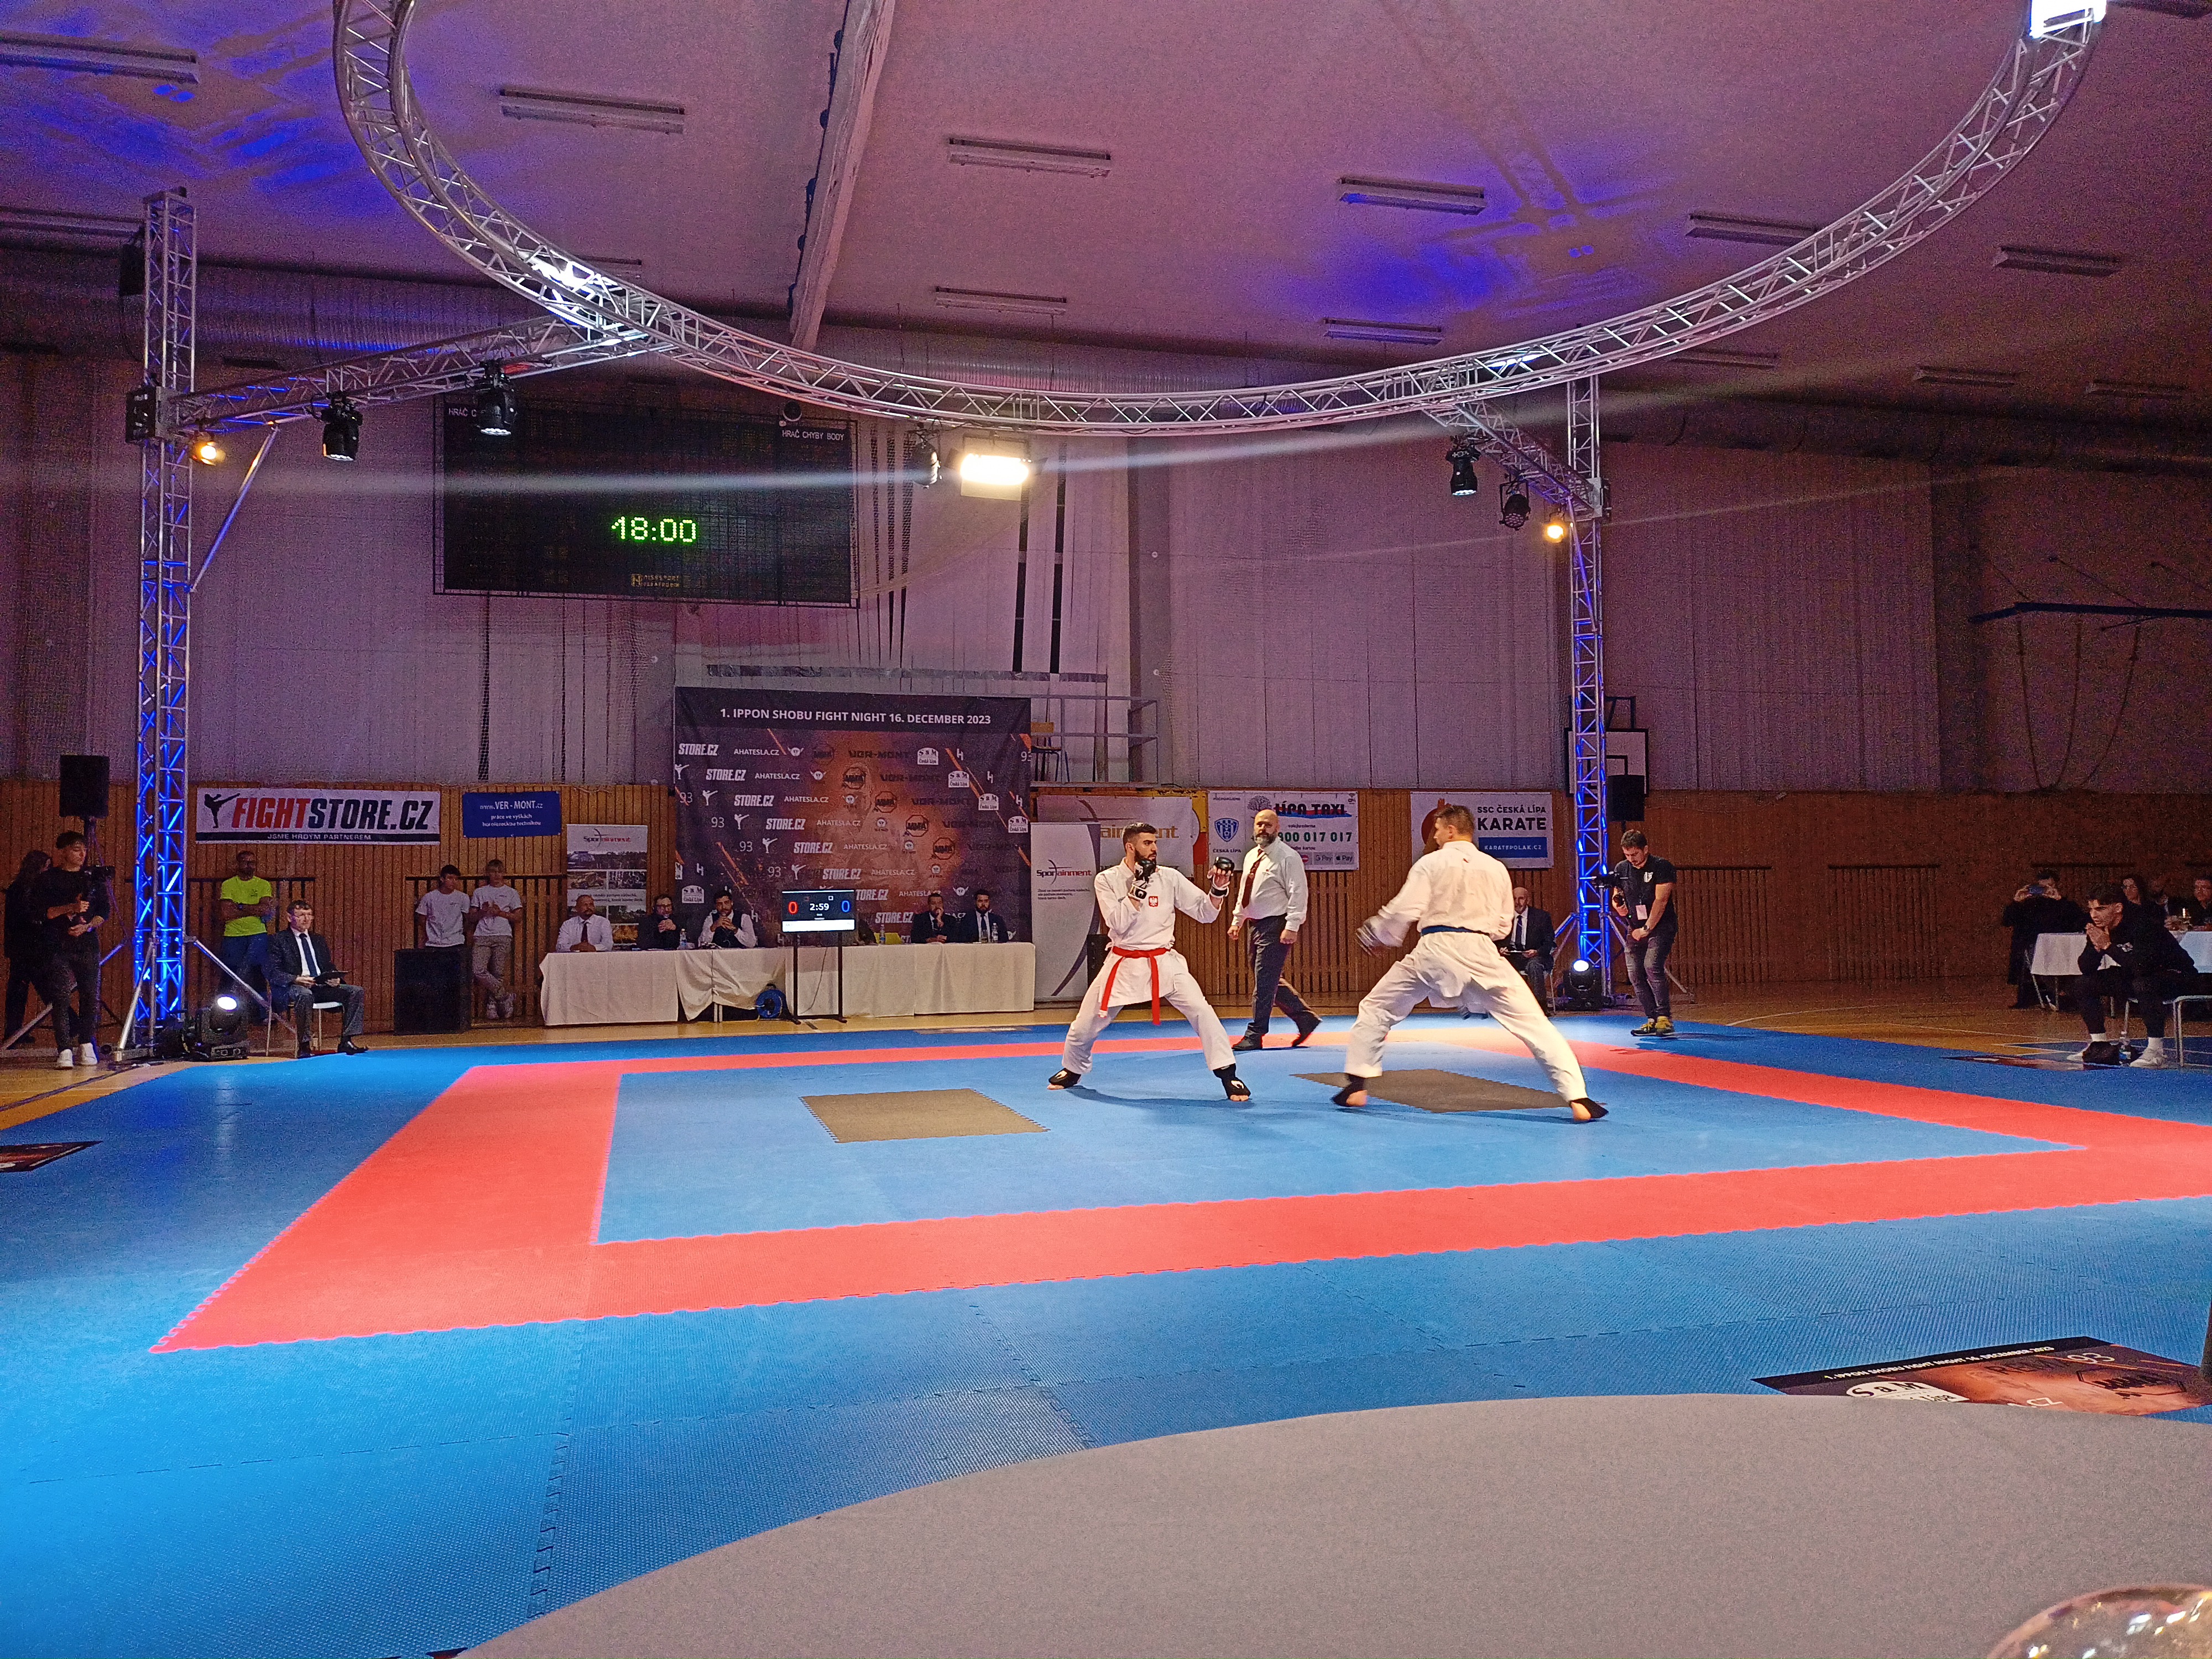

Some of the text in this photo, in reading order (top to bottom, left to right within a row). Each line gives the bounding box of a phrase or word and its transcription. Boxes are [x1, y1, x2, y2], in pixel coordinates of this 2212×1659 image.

[827, 432, 844, 441] BODY
[612, 516, 696, 542] 18:00
[720, 708, 991, 724] 1. IPPON SHOBU FIGHT NIGHT 16. DECEMBER 2023
[678, 743, 719, 756] STORE.CZ
[706, 769, 747, 781] STORE.CZ
[680, 792, 693, 804] 93
[734, 794, 774, 807] STORE.CZ
[231, 797, 435, 830] FIGHTSTORE.CZ
[1275, 800, 1345, 815] LÍPA TAXI
[1496, 804, 1525, 813] ČESKÁ
[1527, 804, 1547, 813] LÍPA
[711, 817, 724, 828] 93
[766, 818, 806, 830] STORE.CZ
[1478, 817, 1547, 831] KARATE
[1304, 832, 1326, 842] 017
[1331, 832, 1352, 842] 017
[739, 841, 753, 852] 93
[794, 842, 833, 854] STORE.CZ
[768, 866, 781, 877] 93
[823, 868, 862, 880] STORE.CZ
[855, 889, 889, 901] TORE.CZ
[787, 901, 799, 915] 0
[810, 903, 830, 911] 2:59
[841, 900, 851, 913] 0
[875, 912, 914, 924] STORE.CZ
[2067, 1352, 2115, 1364] 93
